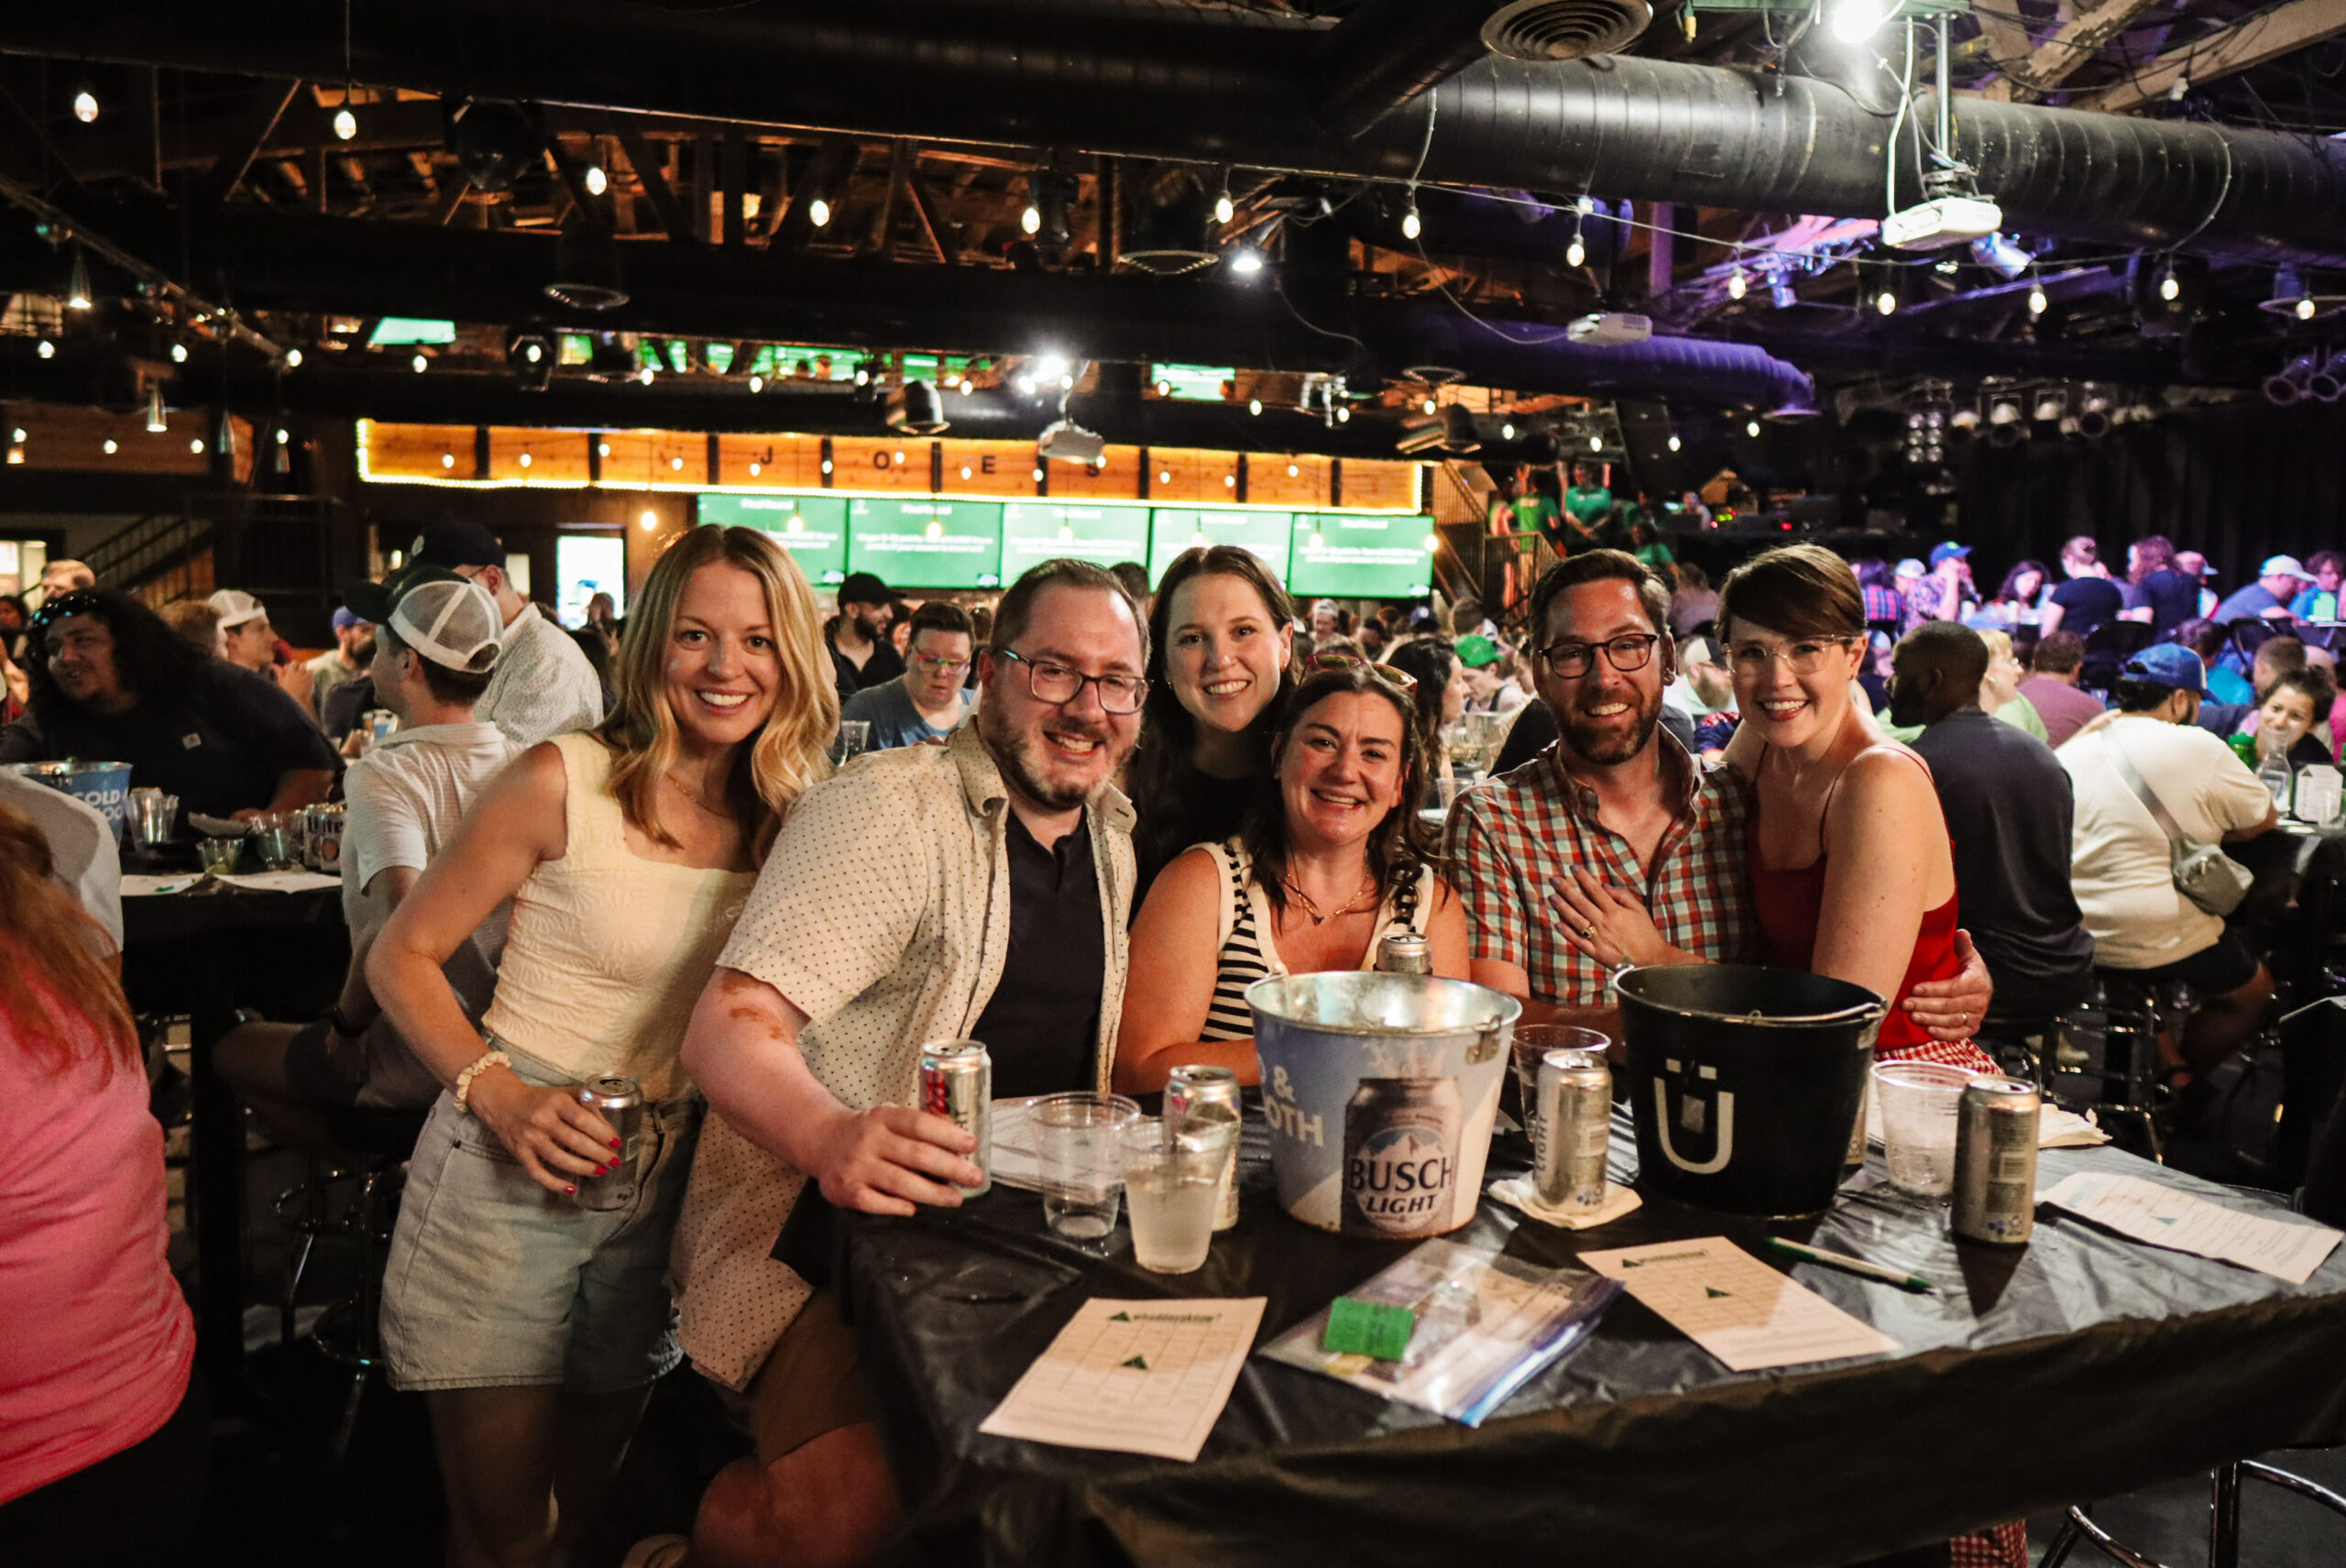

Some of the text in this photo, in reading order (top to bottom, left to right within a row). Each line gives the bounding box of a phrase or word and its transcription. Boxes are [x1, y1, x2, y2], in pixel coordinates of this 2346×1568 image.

[1536, 1113, 1548, 1172] LIGHT
[1349, 1155, 1454, 1192] BUSCH
[1365, 1193, 1439, 1214] LIGHT
